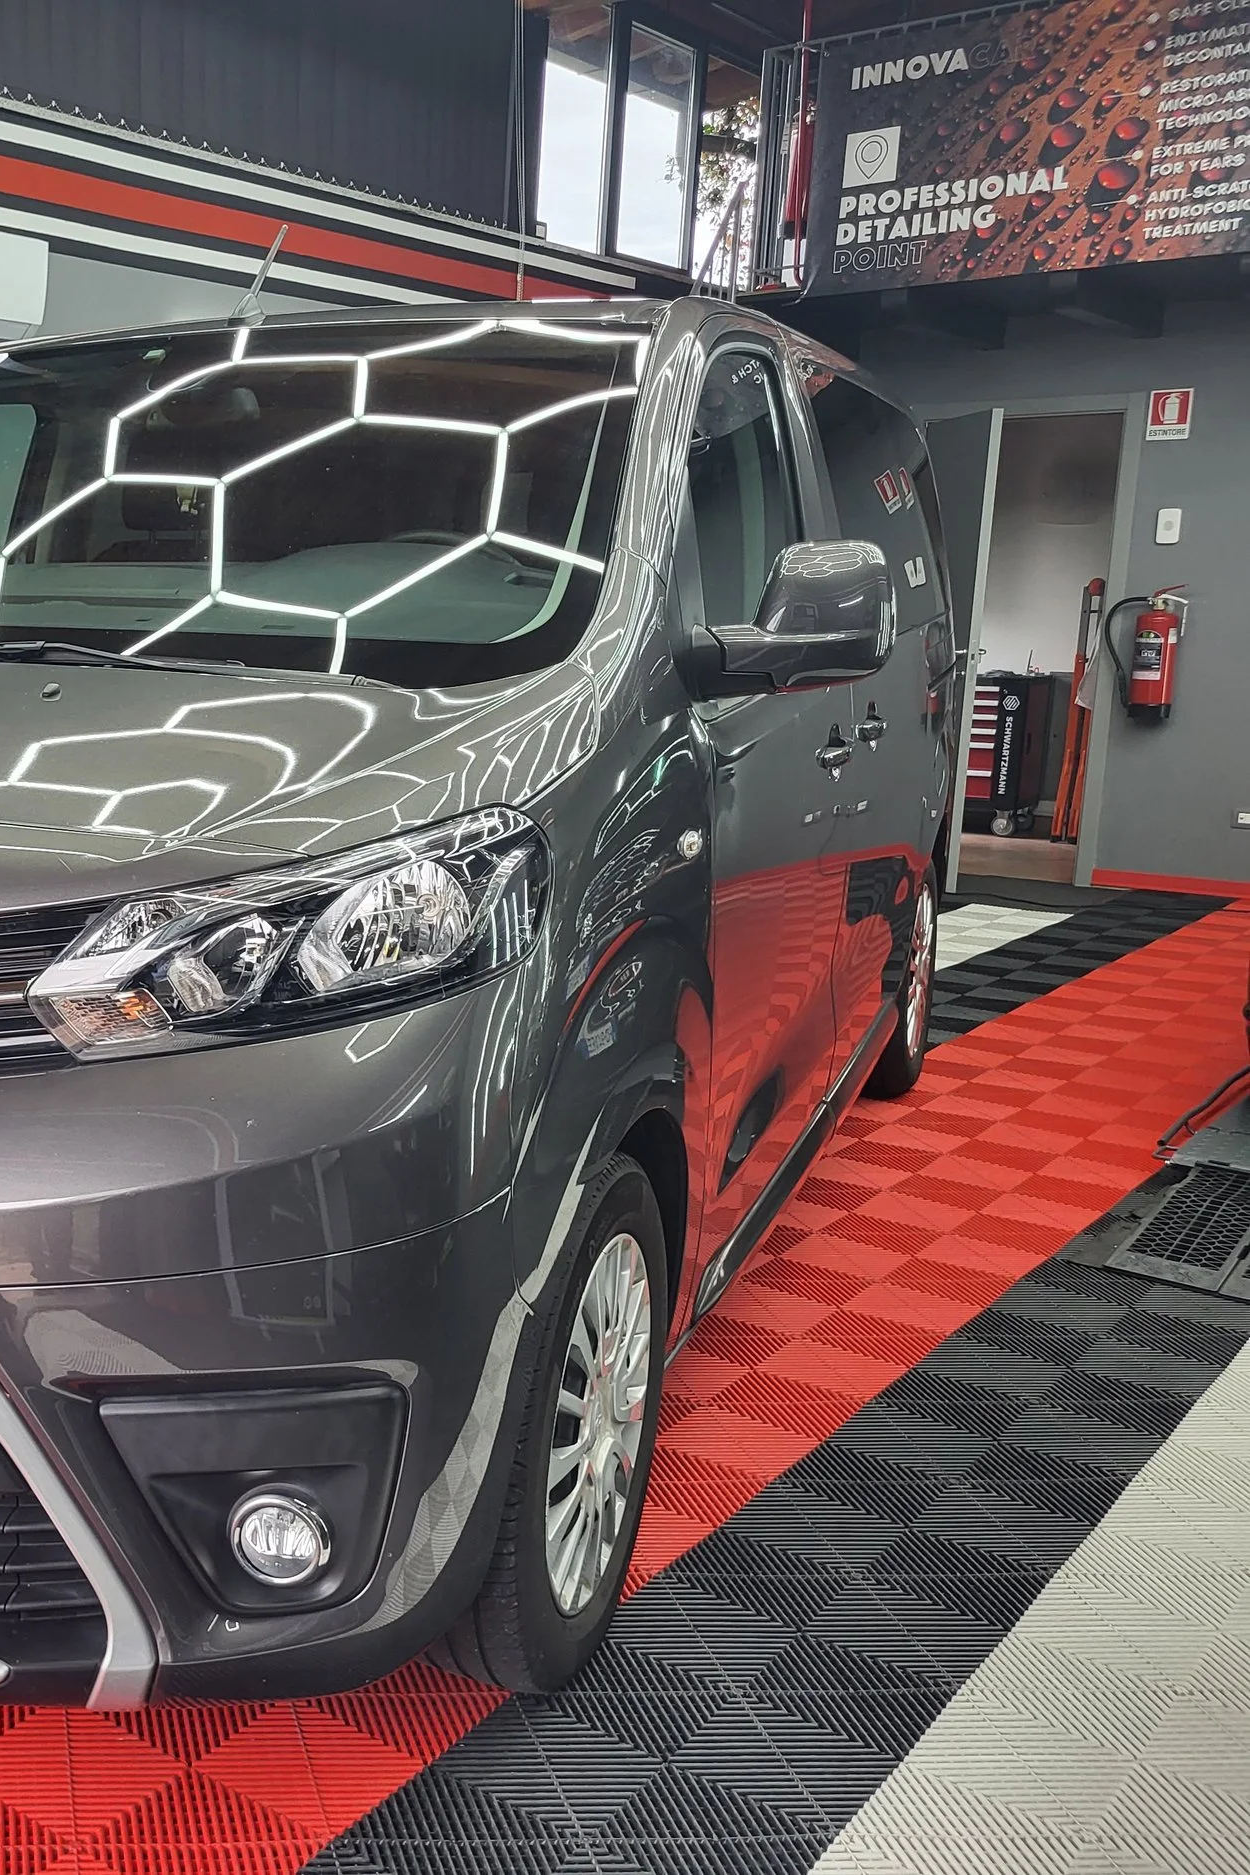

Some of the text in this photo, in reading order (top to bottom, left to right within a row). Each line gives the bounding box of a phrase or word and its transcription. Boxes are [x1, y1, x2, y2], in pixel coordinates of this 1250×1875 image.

[1168, 2, 1212, 21] SAFE
[1164, 22, 1250, 50] ENZYMAT
[1152, 137, 1231, 160] EXTREME
[1150, 153, 1246, 178] FOR YEARS
[839, 166, 1069, 219] PROFESSIONAL
[1145, 179, 1250, 206] ANTI-SCRAT
[836, 204, 996, 246] DETAILING
[1142, 217, 1244, 240] TREATMENT
[833, 240, 927, 273] POINT
[1148, 427, 1187, 437] ESTINTORE
[998, 716, 1013, 794] SCHWARTZMANN
